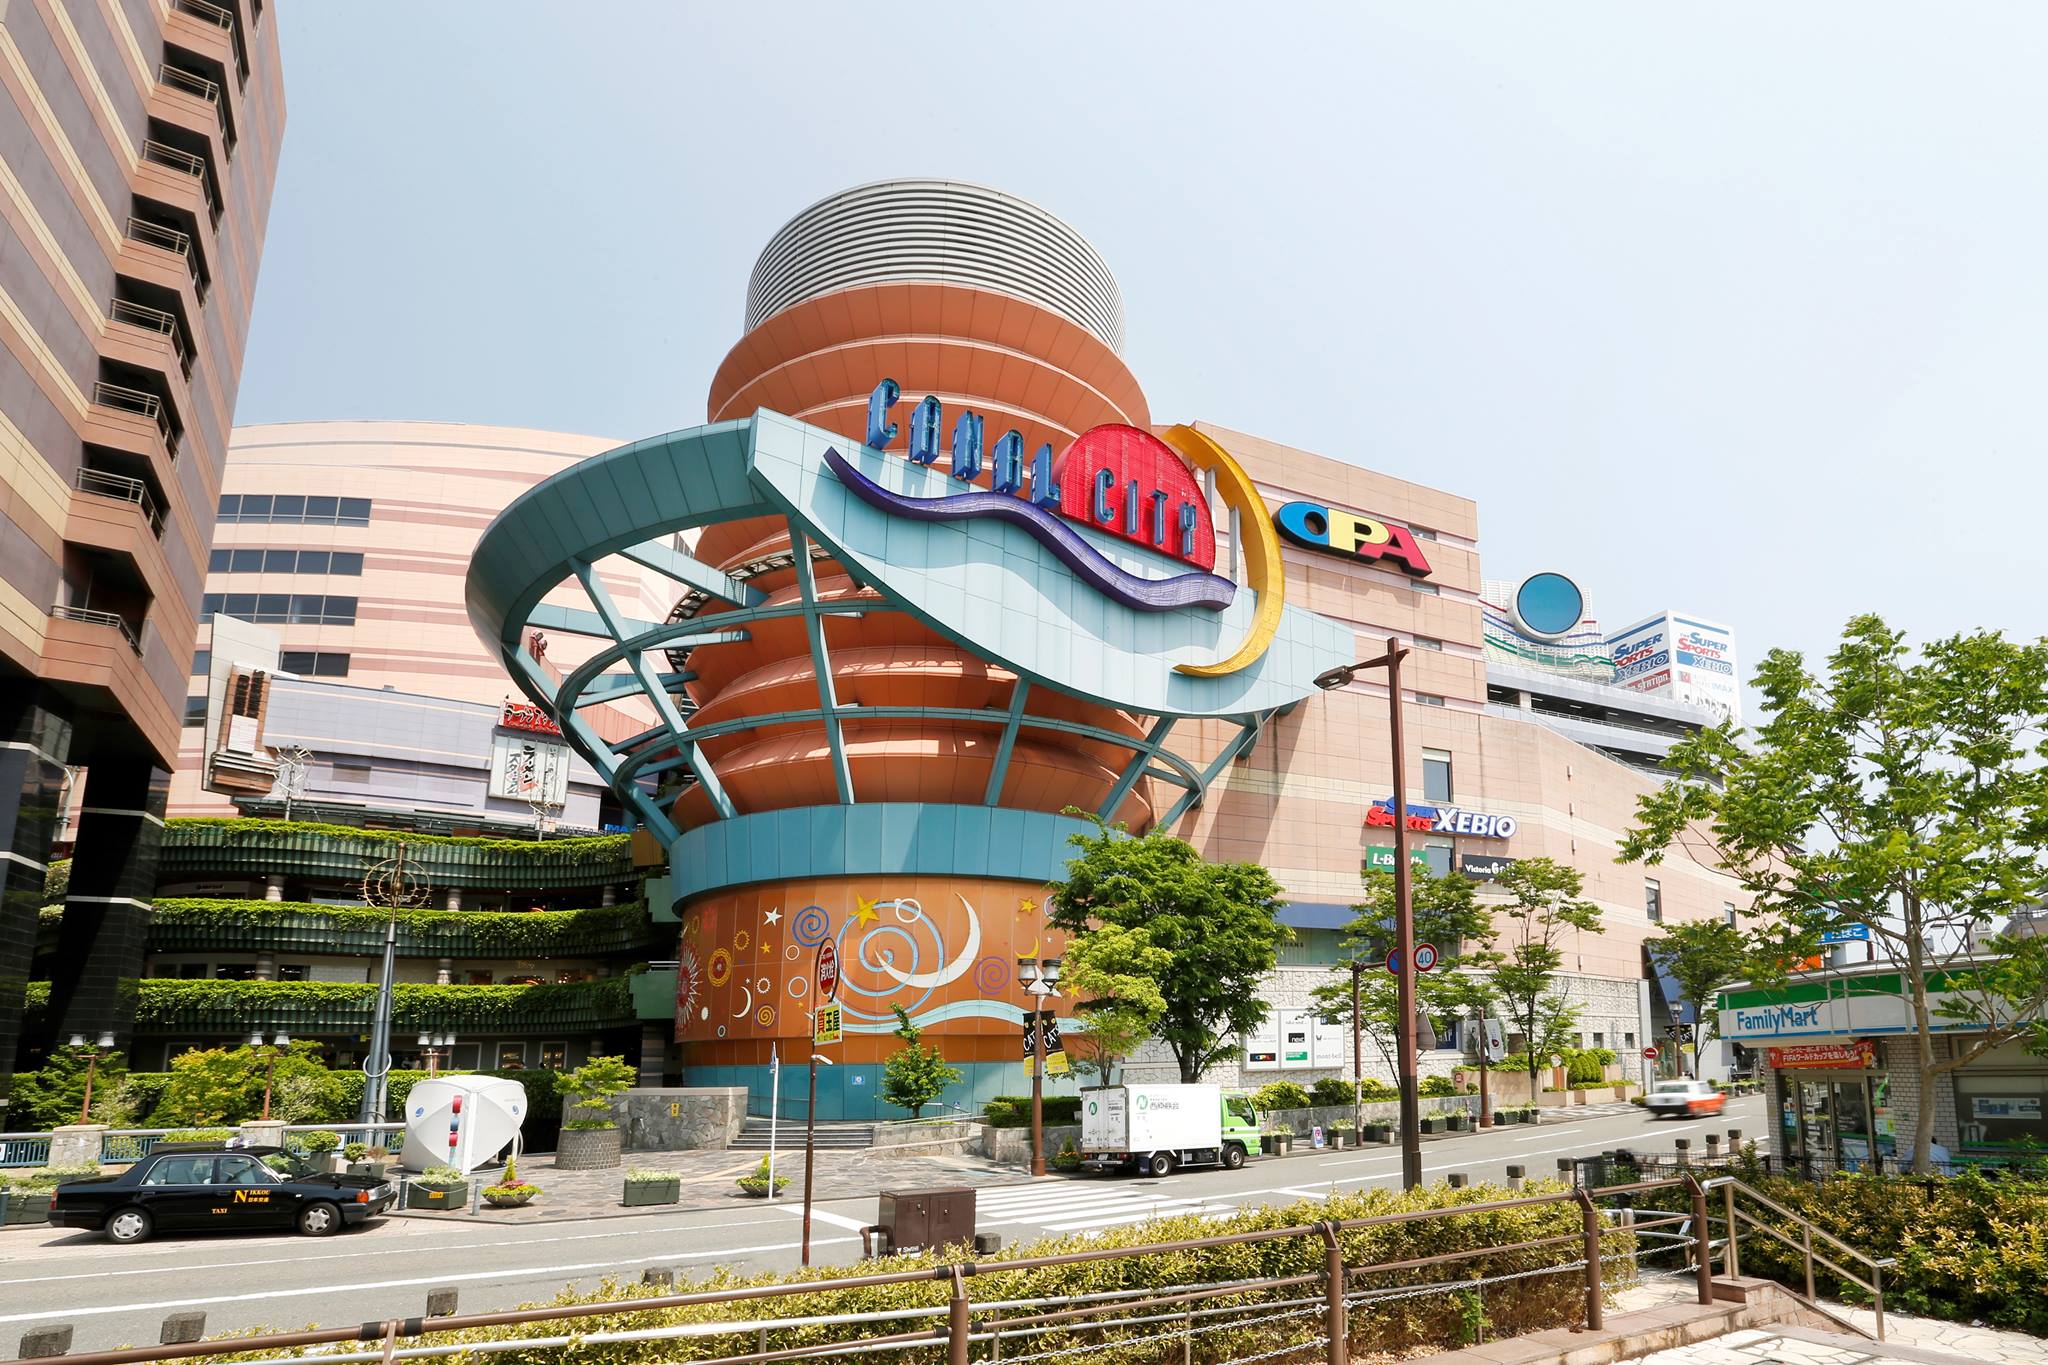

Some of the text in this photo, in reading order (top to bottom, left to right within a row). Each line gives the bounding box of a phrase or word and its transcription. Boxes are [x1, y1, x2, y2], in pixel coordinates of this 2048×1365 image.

[866, 378, 1197, 557] CANAL CITY
[1273, 500, 1433, 578] OPA
[1614, 633, 1663, 659] SUPER
[1677, 637, 1721, 659] SPORTS
[1690, 632, 1728, 652] SUPER
[1614, 646, 1654, 668] PORTS
[1692, 655, 1732, 675] XEBIO
[1367, 806, 1518, 839] SPRTS XEBIO
[1465, 863, 1491, 875] Victoria
[1418, 951, 1432, 965] 40
[1736, 1006, 1819, 1034] FamilyMart
[1023, 1031, 1036, 1051] CAT
